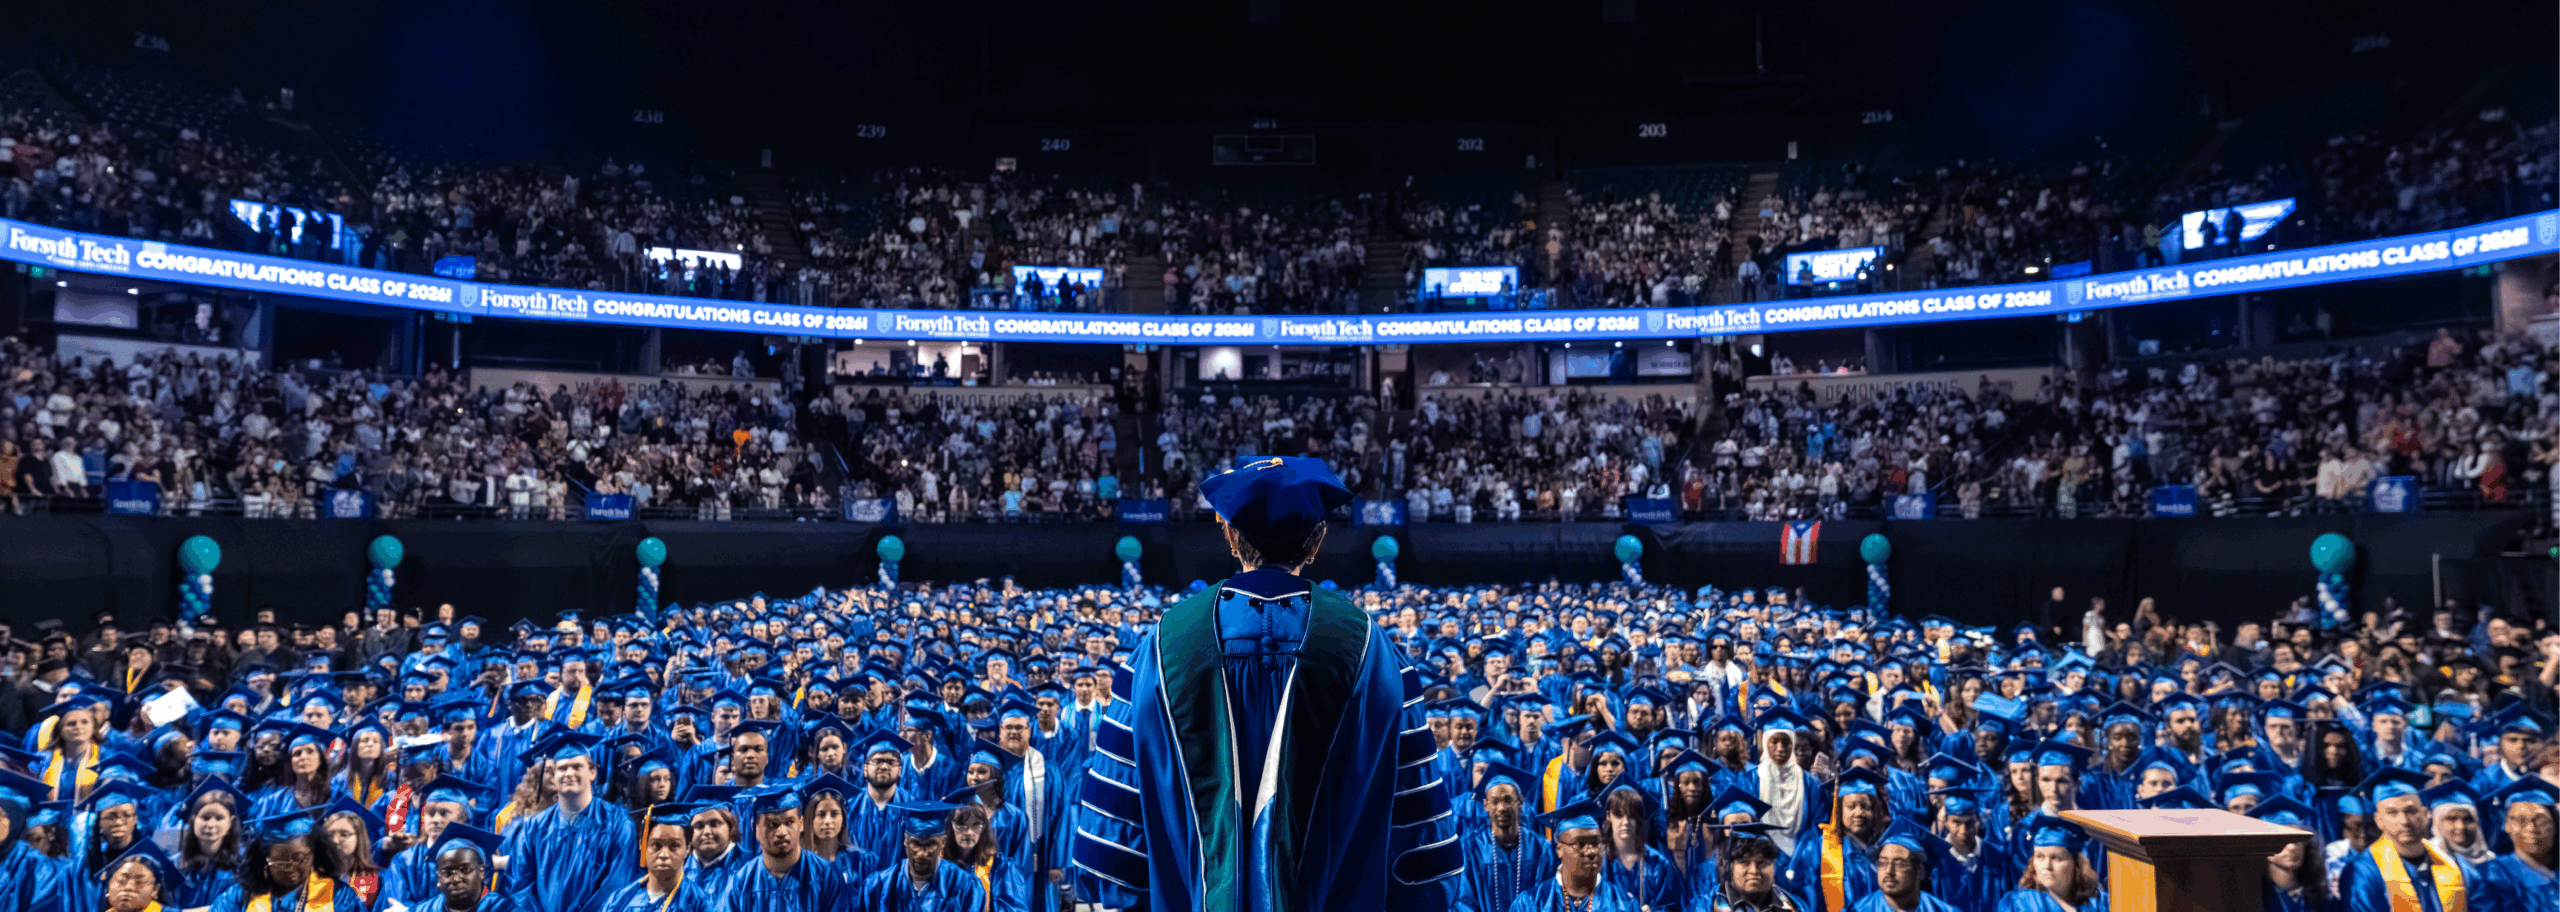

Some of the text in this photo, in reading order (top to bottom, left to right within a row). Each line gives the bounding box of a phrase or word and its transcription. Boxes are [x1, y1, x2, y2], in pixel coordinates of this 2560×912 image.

[857, 124, 887, 138] 239
[1639, 123, 1668, 138] 203
[1041, 138, 1071, 152] 240
[1457, 137, 1485, 152] 202
[9, 227, 78, 261] Forsyth
[78, 239, 131, 266] Tech
[135, 250, 326, 288] CONGRATULATIONS
[326, 273, 381, 295] CLASS
[382, 280, 407, 297] OF
[407, 283, 453, 303] 2026!
[2085, 275, 2149, 301] Forsyth
[2147, 270, 2190, 293] Tech
[2193, 249, 2381, 288] CONGRATULATIONS
[2381, 240, 2450, 266] CLASS
[2452, 235, 2479, 257] OF
[2479, 226, 2529, 253] 2026!
[480, 288, 547, 313] Forsyth
[547, 292, 588, 313] Tech
[593, 299, 751, 324] CONGRATULATIONS
[752, 310, 801, 327] CLASS
[802, 313, 825, 329] OF
[825, 315, 869, 331] 2026!
[1666, 310, 1725, 332] Forsyth
[1724, 307, 1761, 326] Tech
[1764, 298, 1921, 324] CONGRATULATIONS
[1921, 294, 1976, 314] CLASS
[1977, 293, 2003, 310] OF
[2004, 289, 2052, 308] 2026!
[895, 314, 953, 336] Forsyth
[953, 315, 990, 333] Tech
[993, 318, 1141, 336] CONGRATULATIONS
[1141, 321, 1190, 337] CLASS
[1190, 322, 1213, 337] OF
[1213, 322, 1255, 337] 2026!
[1280, 319, 1337, 340] Forsyth
[1336, 319, 1373, 336] Tech
[1376, 318, 1523, 336] CONGRATULATIONS
[1523, 317, 1573, 333] CLASS
[1573, 317, 1596, 332] OF
[1597, 316, 1640, 332] 2026!
